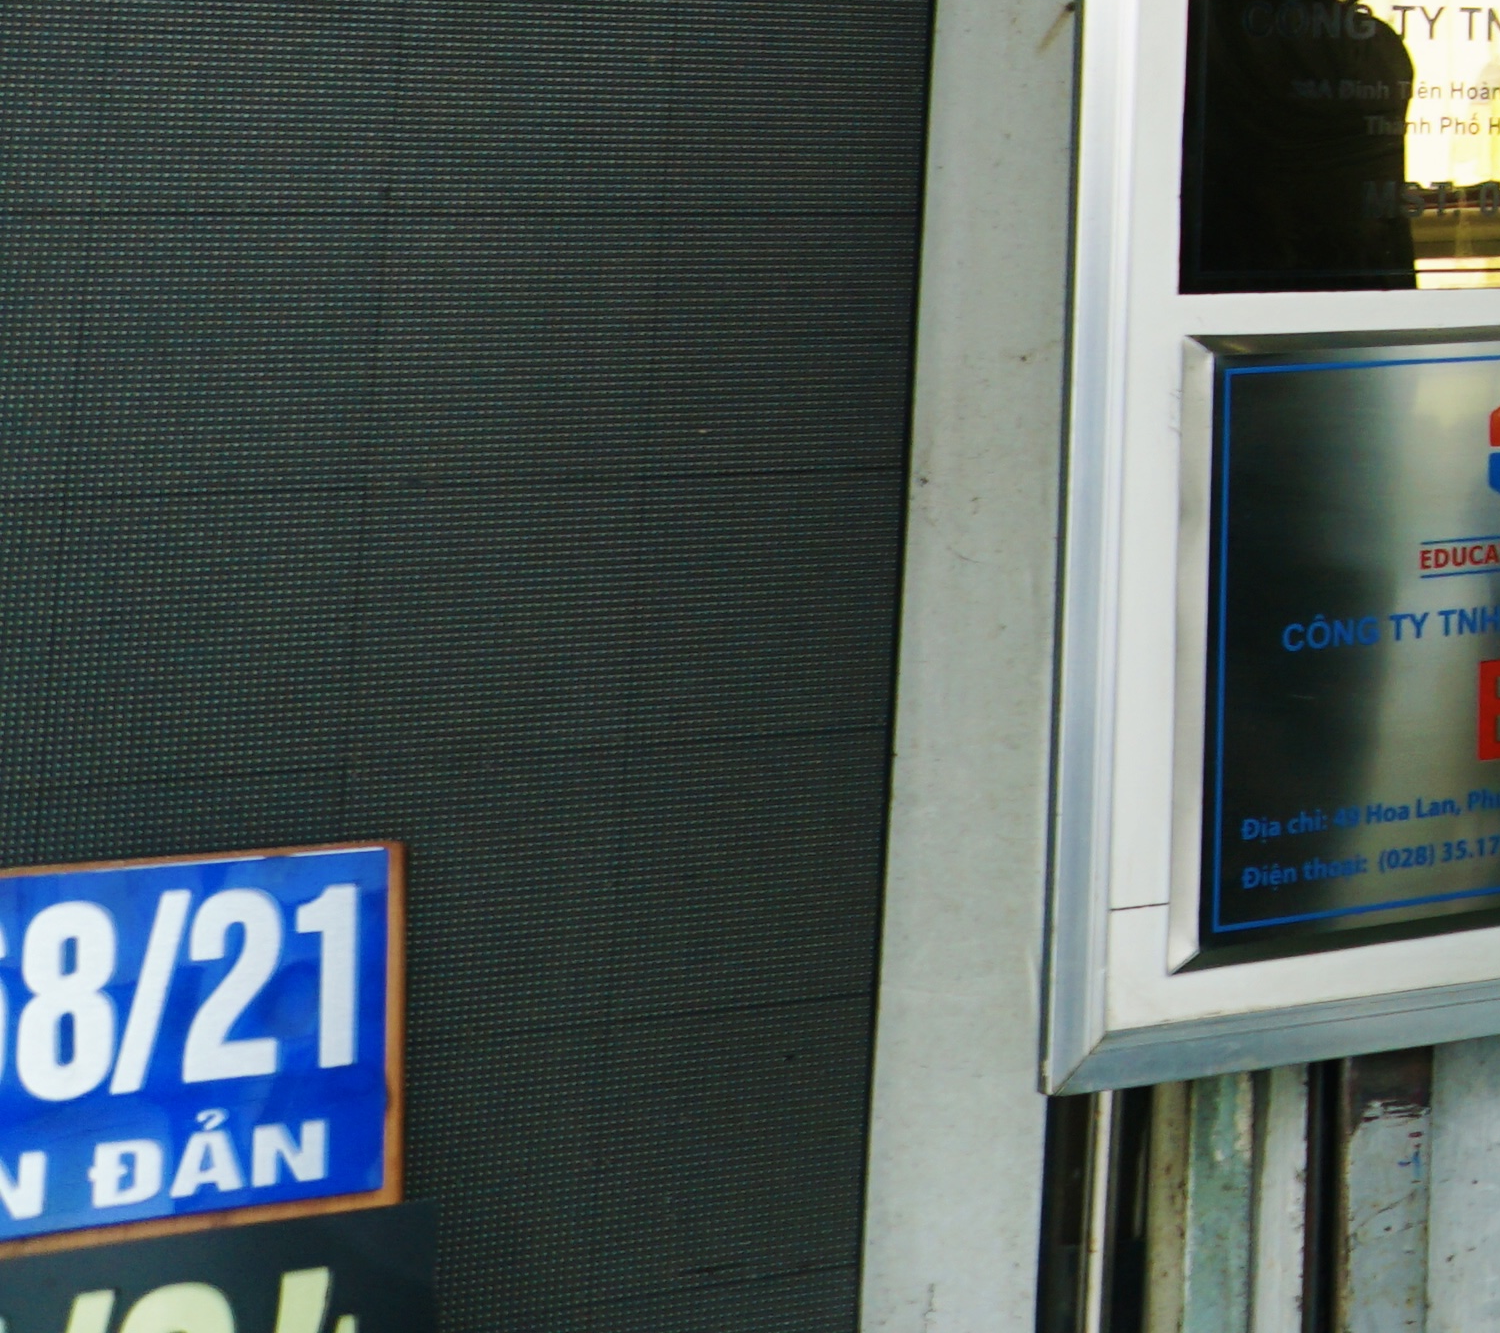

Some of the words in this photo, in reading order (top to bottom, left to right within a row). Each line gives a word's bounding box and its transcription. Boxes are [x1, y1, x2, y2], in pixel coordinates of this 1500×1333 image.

[1240, 863, 1298, 892] Điện
[1303, 855, 1369, 885] thoại:
[1378, 842, 1437, 874] (028)
[0, 883, 359, 1102] 8/21
[88, 1108, 327, 1210] ĐẢN
